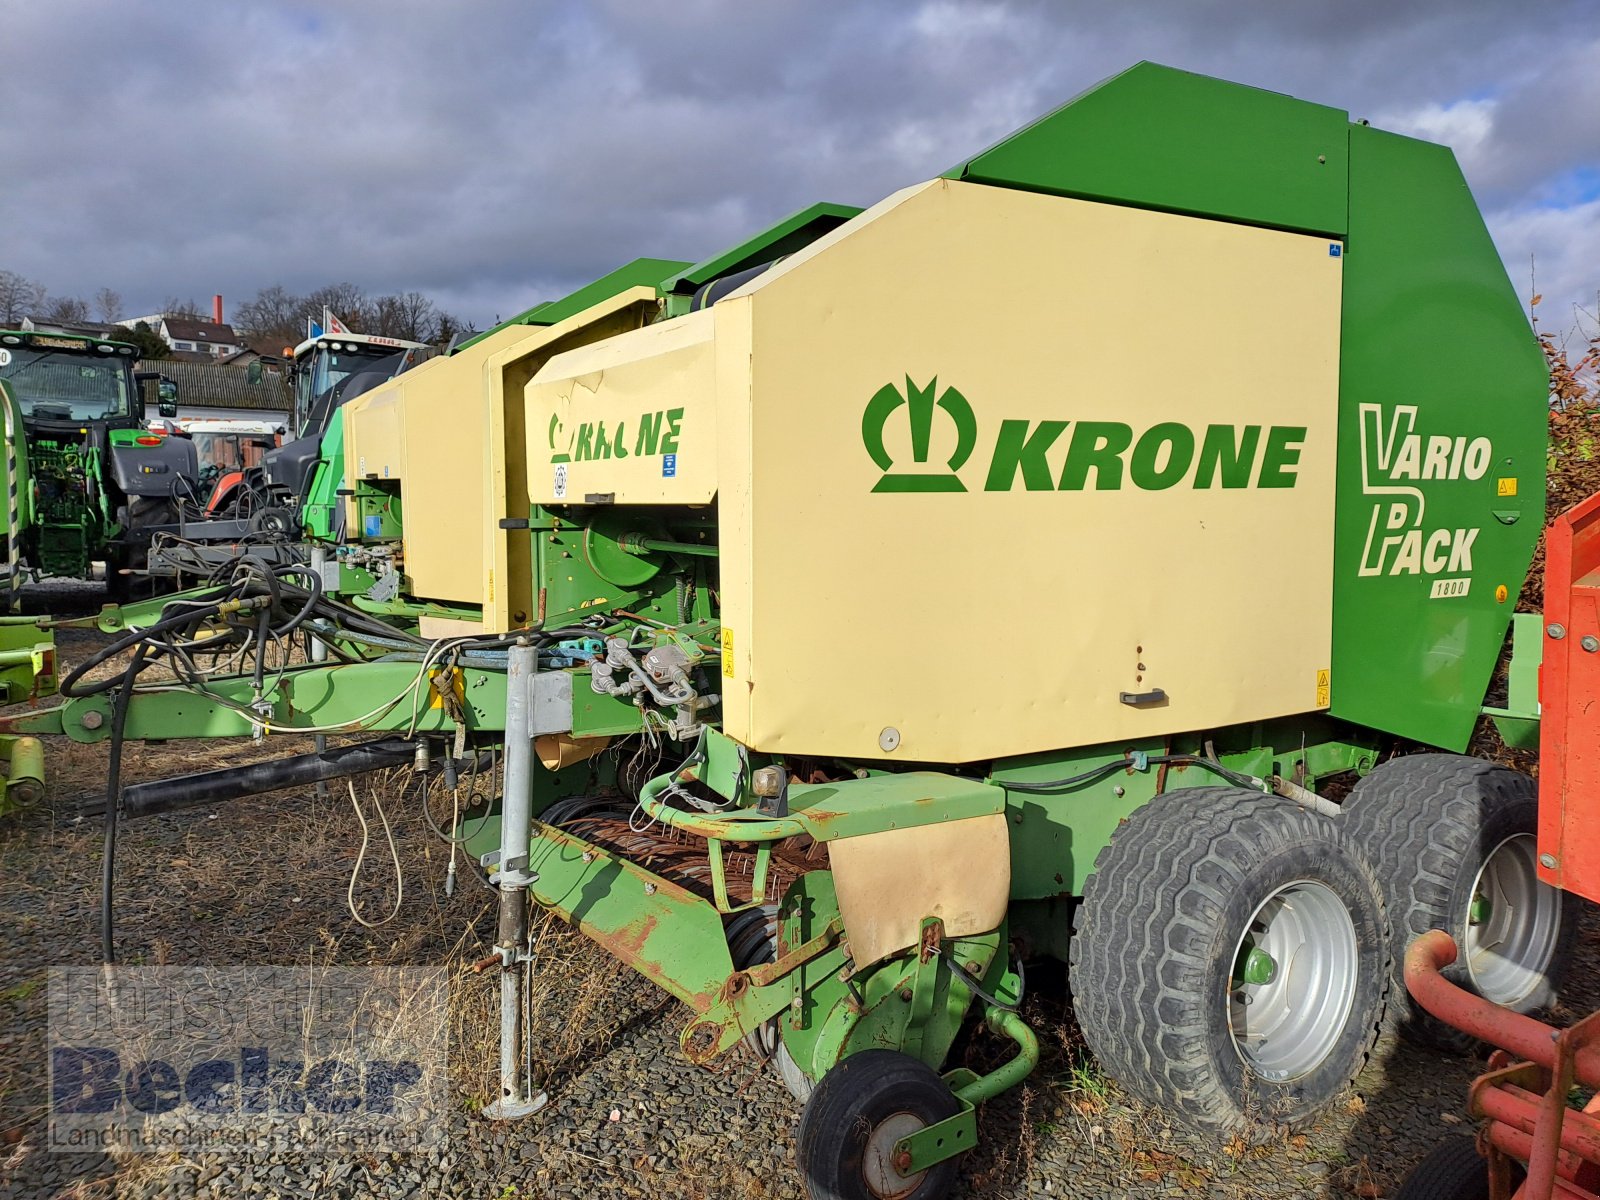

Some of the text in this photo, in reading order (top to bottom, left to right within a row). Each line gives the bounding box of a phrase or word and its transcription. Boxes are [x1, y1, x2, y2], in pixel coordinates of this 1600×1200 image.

[984, 419, 1307, 491] KRONE
[1357, 487, 1480, 577] PACK
[1435, 580, 1466, 597] 1800
